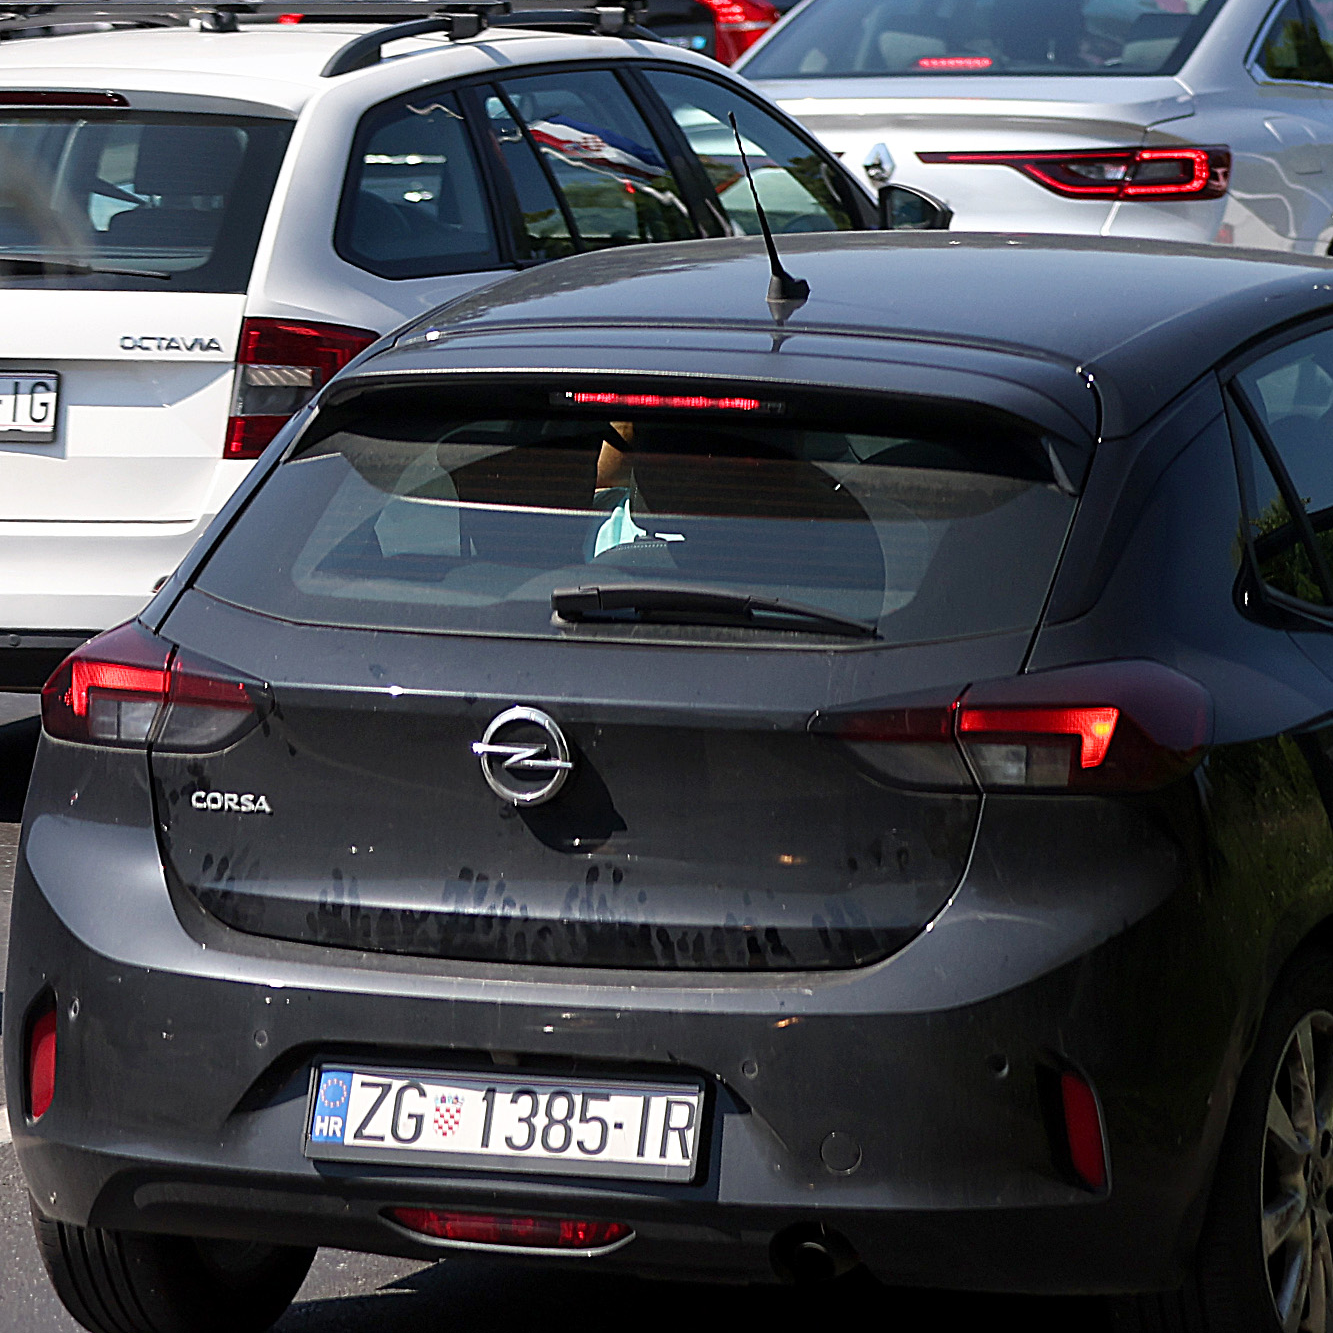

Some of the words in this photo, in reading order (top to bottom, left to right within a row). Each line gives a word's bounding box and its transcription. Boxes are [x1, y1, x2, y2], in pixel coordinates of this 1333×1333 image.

[120, 335, 222, 352] OCTAVIA
[191, 790, 273, 815] CORSA
[315, 1115, 343, 1138] HR
[353, 1080, 427, 1144] ZG
[480, 1087, 696, 1161] 1385-IR
